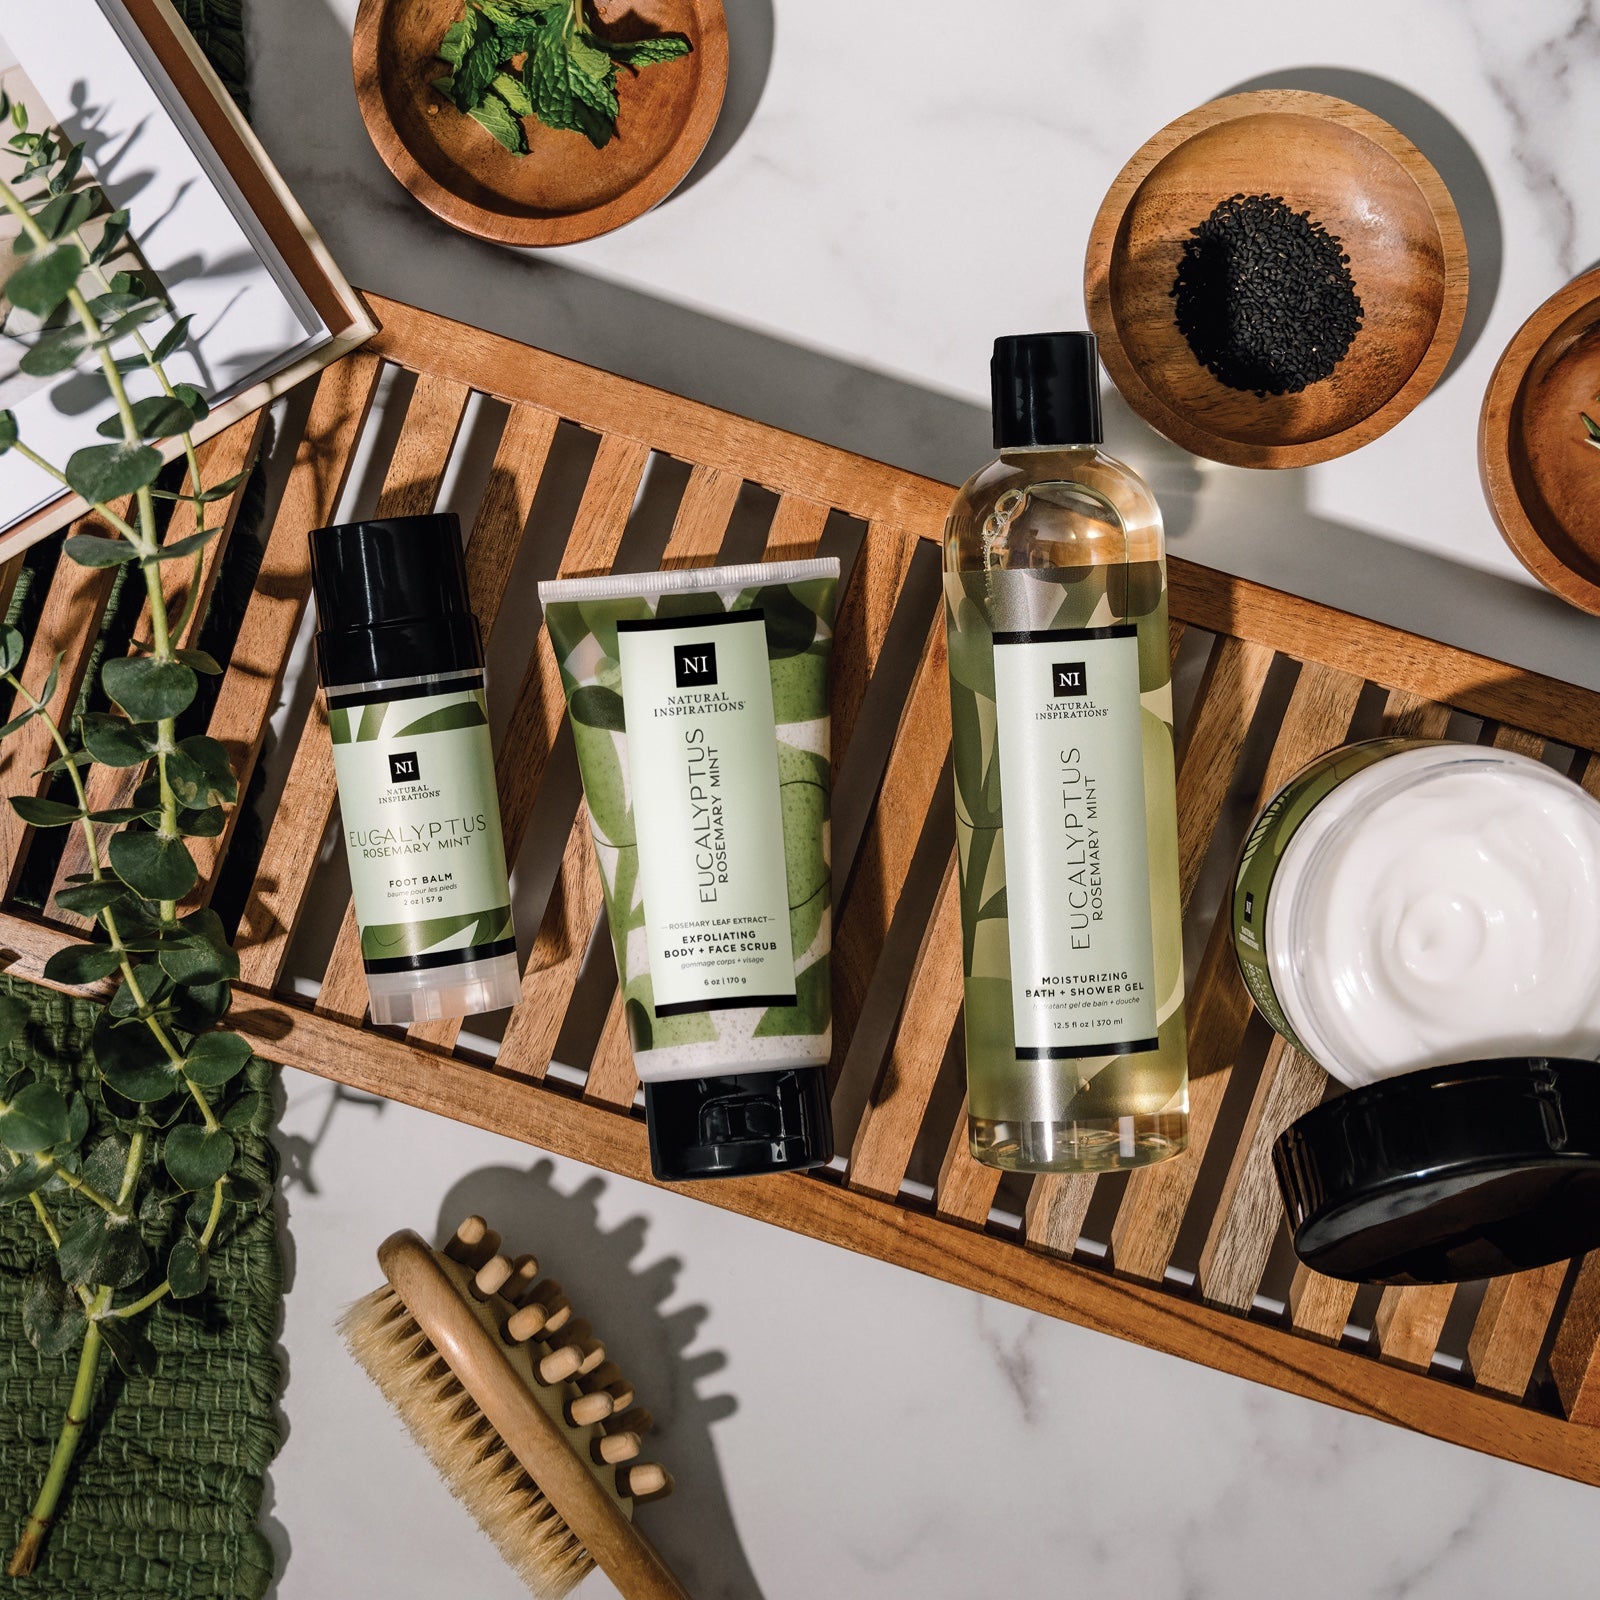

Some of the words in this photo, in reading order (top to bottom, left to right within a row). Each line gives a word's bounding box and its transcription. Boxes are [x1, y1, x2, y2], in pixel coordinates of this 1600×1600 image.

[683, 656, 708, 674] NI
[1059, 672, 1080, 687] NI
[668, 692, 729, 705] NATURAL
[654, 701, 745, 717] INSPIRATIONS
[1047, 702, 1096, 711] NATURAL
[1036, 709, 1108, 720] INSPIRATIONS
[394, 760, 414, 774] NI
[708, 746, 720, 786] MINT
[379, 790, 440, 804] INSPIRATIONS
[387, 785, 429, 795] NATURAL
[1085, 776, 1097, 819] MINT
[685, 729, 717, 903] EUCALYPTUS
[712, 796, 728, 883] ROSEMARY
[363, 842, 430, 858] ROSEMARY
[438, 836, 471, 849] MINT
[1060, 748, 1090, 950] EUCALYPTUS
[390, 878, 417, 888] FOOT
[423, 873, 452, 884] BALM
[1089, 828, 1103, 921] ROSEMARY
[410, 888, 426, 897] pour
[439, 883, 457, 892] pieds
[733, 916, 767, 924] EXTRACT
[683, 931, 756, 944] EXFOLIATING
[665, 948, 694, 958] BODY
[709, 945, 736, 954] FACE
[741, 942, 777, 951] SCRUB
[681, 960, 715, 969] gommage
[716, 959, 735, 967] corps
[1043, 972, 1127, 985] MOISTURIZING
[1026, 989, 1055, 997] BATH
[1071, 985, 1120, 996] SHOWER
[1125, 983, 1144, 991] GEL
[1069, 1001, 1080, 1009] gel
[1116, 997, 1140, 1005] douche
[1054, 1021, 1069, 1029] 12.5
